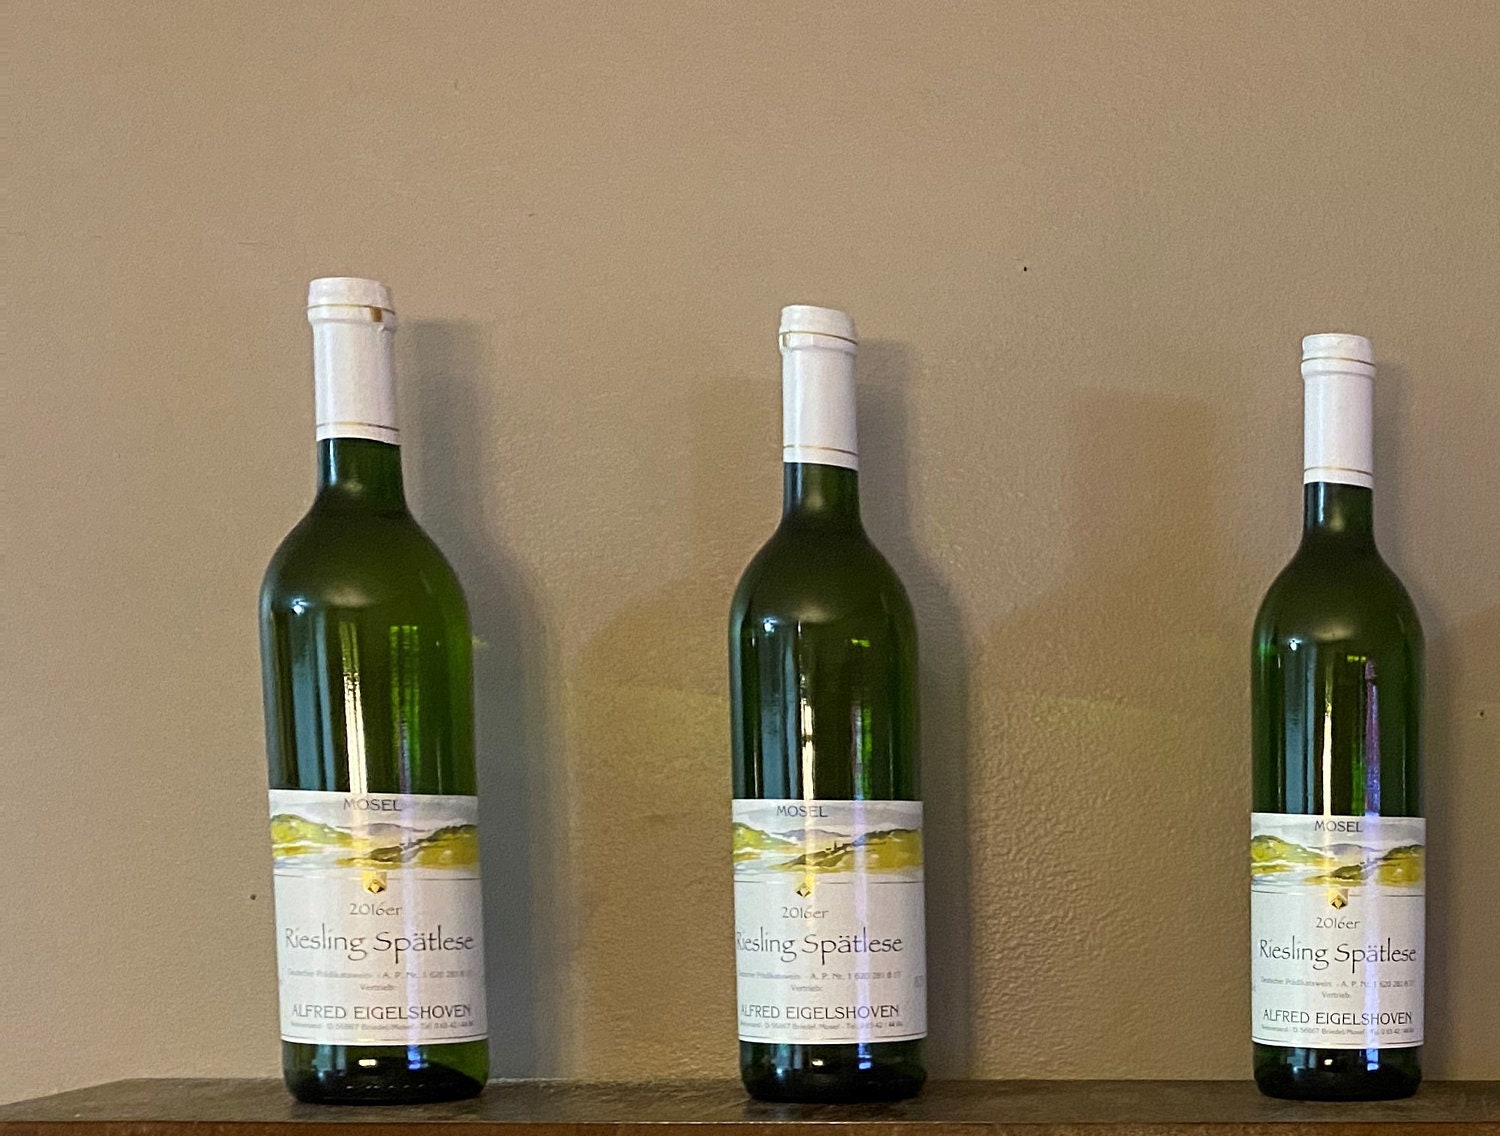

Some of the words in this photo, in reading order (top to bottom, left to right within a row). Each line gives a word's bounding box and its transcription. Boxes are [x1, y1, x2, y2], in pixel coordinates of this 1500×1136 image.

[343, 797, 402, 812] MOSEL
[776, 804, 829, 818] MOSEL
[1314, 819, 1364, 833] MOSEL
[349, 901, 403, 916] 2016er
[781, 906, 830, 919] 2016er
[1315, 916, 1361, 930] 2016er
[285, 922, 367, 962] Riesling
[372, 924, 475, 964] Spätlese
[801, 926, 904, 966] Spätlese
[1259, 935, 1330, 971] Riesling
[1333, 937, 1418, 974] Spätlese
[291, 1004, 347, 1019] ALFRED
[353, 1004, 471, 1020] EIGELSHOVEN
[786, 1004, 900, 1020] EIGELSHOVEN
[1262, 1008, 1310, 1024] ALFRED
[1315, 1011, 1413, 1026] EIGELSHOVEN
